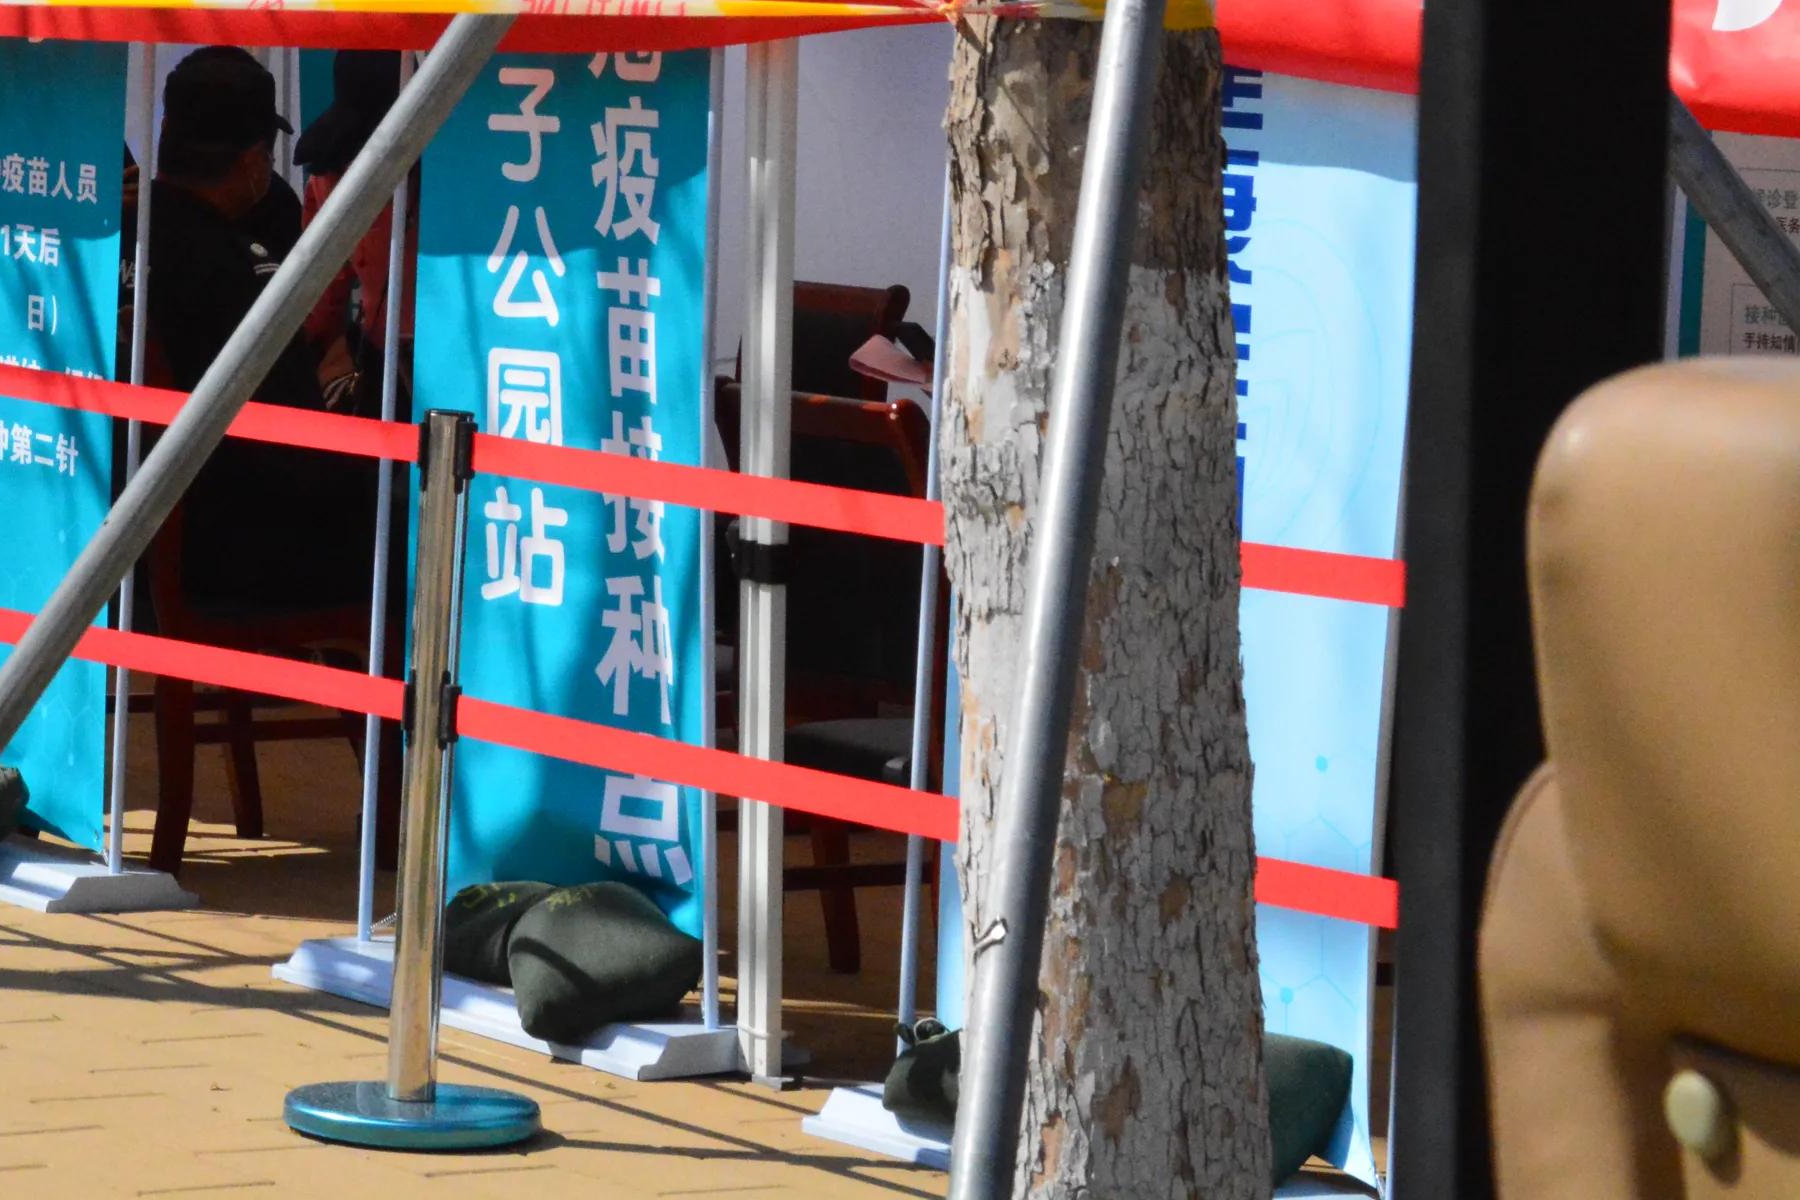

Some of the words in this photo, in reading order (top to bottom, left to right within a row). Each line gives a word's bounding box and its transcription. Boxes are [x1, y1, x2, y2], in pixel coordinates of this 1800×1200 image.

[588, 50, 693, 886] 疫苗接种点
